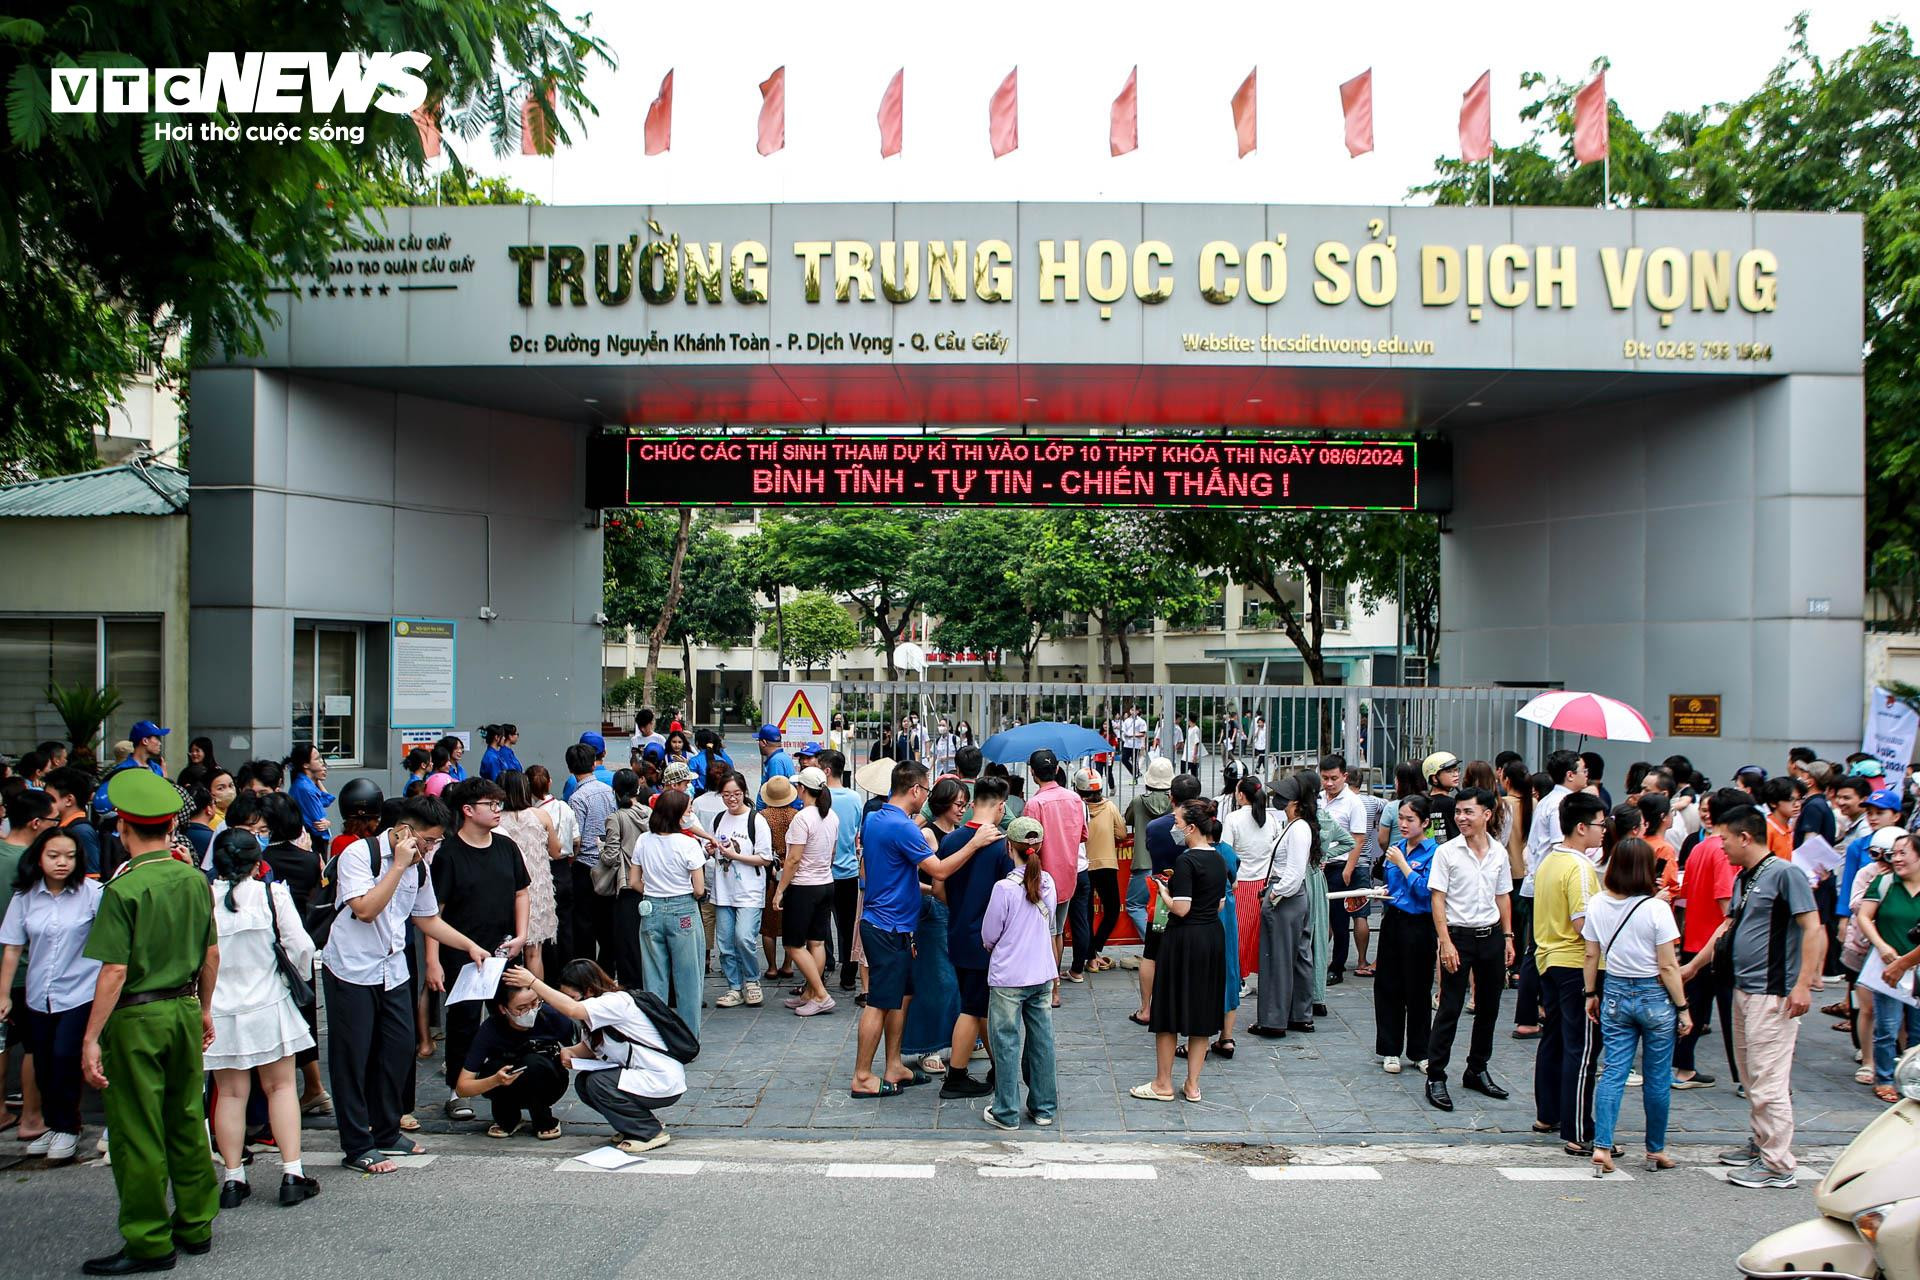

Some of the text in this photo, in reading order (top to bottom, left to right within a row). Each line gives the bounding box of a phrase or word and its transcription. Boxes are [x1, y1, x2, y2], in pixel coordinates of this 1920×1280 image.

[358, 261, 380, 277] TẠO
[384, 259, 418, 276] QUẬN
[508, 217, 1779, 327] TRƯỜNG TRUNG HỌC CƠ SỞ DỊCH VỌNG
[509, 334, 539, 353] Đc:
[544, 332, 600, 356] Đường
[606, 331, 669, 356] Nguyễn
[674, 333, 726, 352] Khánh
[729, 333, 770, 352] Toàn
[788, 333, 802, 351] P.
[807, 332, 844, 355] Dịch
[849, 332, 893, 356] Vọng
[911, 332, 929, 352] Q.
[934, 330, 966, 352] Cầu
[971, 330, 1010, 355] Giấy
[1183, 333, 1434, 357] Website: thcsdichvong.edu.vn
[640, 441, 1404, 465] CHÚC CÁC THÍ SINH THAM DỰ KÌ THI VÀO LỚP 10 THPT KHÓA THI NGÀY 08/6/2024
[753, 463, 825, 494] BÌNH
[834, 463, 904, 494] TĨNH
[932, 470, 978, 499] TỰ
[985, 470, 1032, 494] TIN
[1060, 465, 1154, 496] CHIẾN
[1164, 466, 1273, 497] THẮNG
[1283, 473, 1289, 497] !
